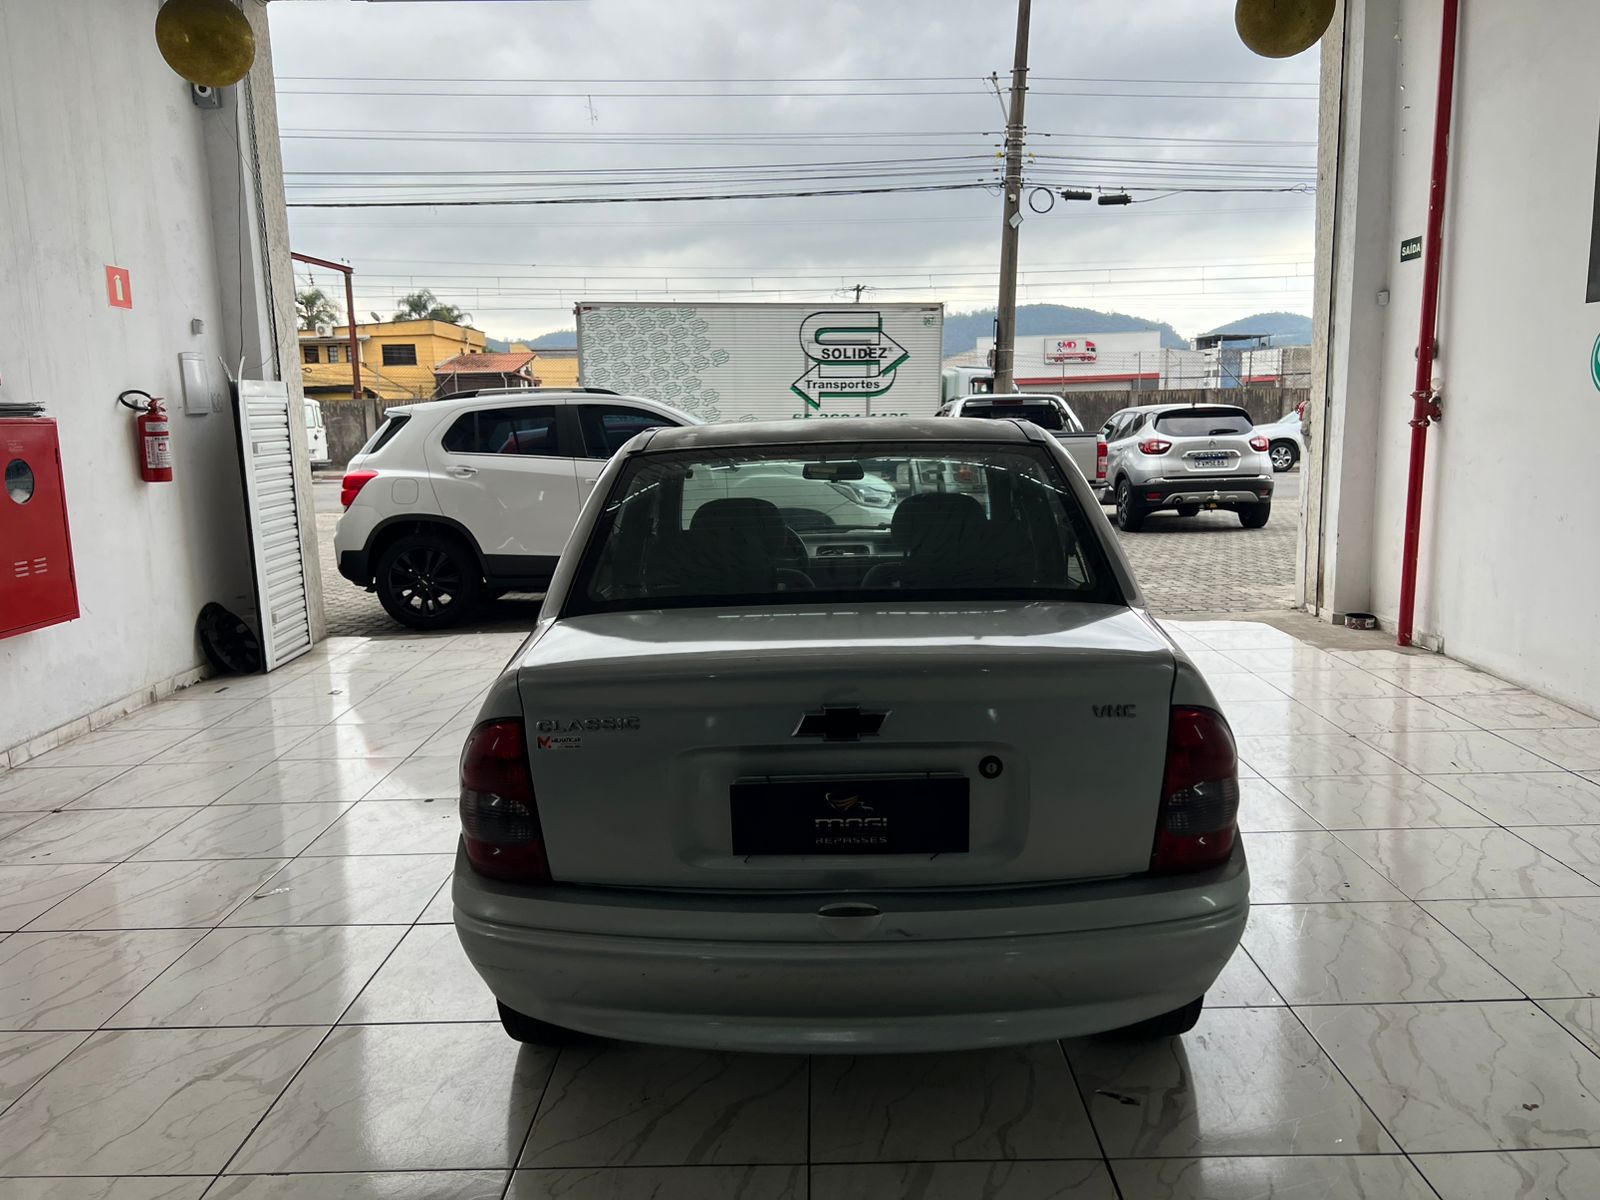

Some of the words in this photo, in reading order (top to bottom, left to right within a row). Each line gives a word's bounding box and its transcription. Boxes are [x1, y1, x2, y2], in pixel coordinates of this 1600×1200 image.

[1402, 242, 1421, 257] SAÍDA
[821, 347, 888, 359] SOLIDEZ
[805, 380, 880, 391] Transportes
[1091, 704, 1137, 718] VHC
[536, 716, 641, 733] CLASSIC
